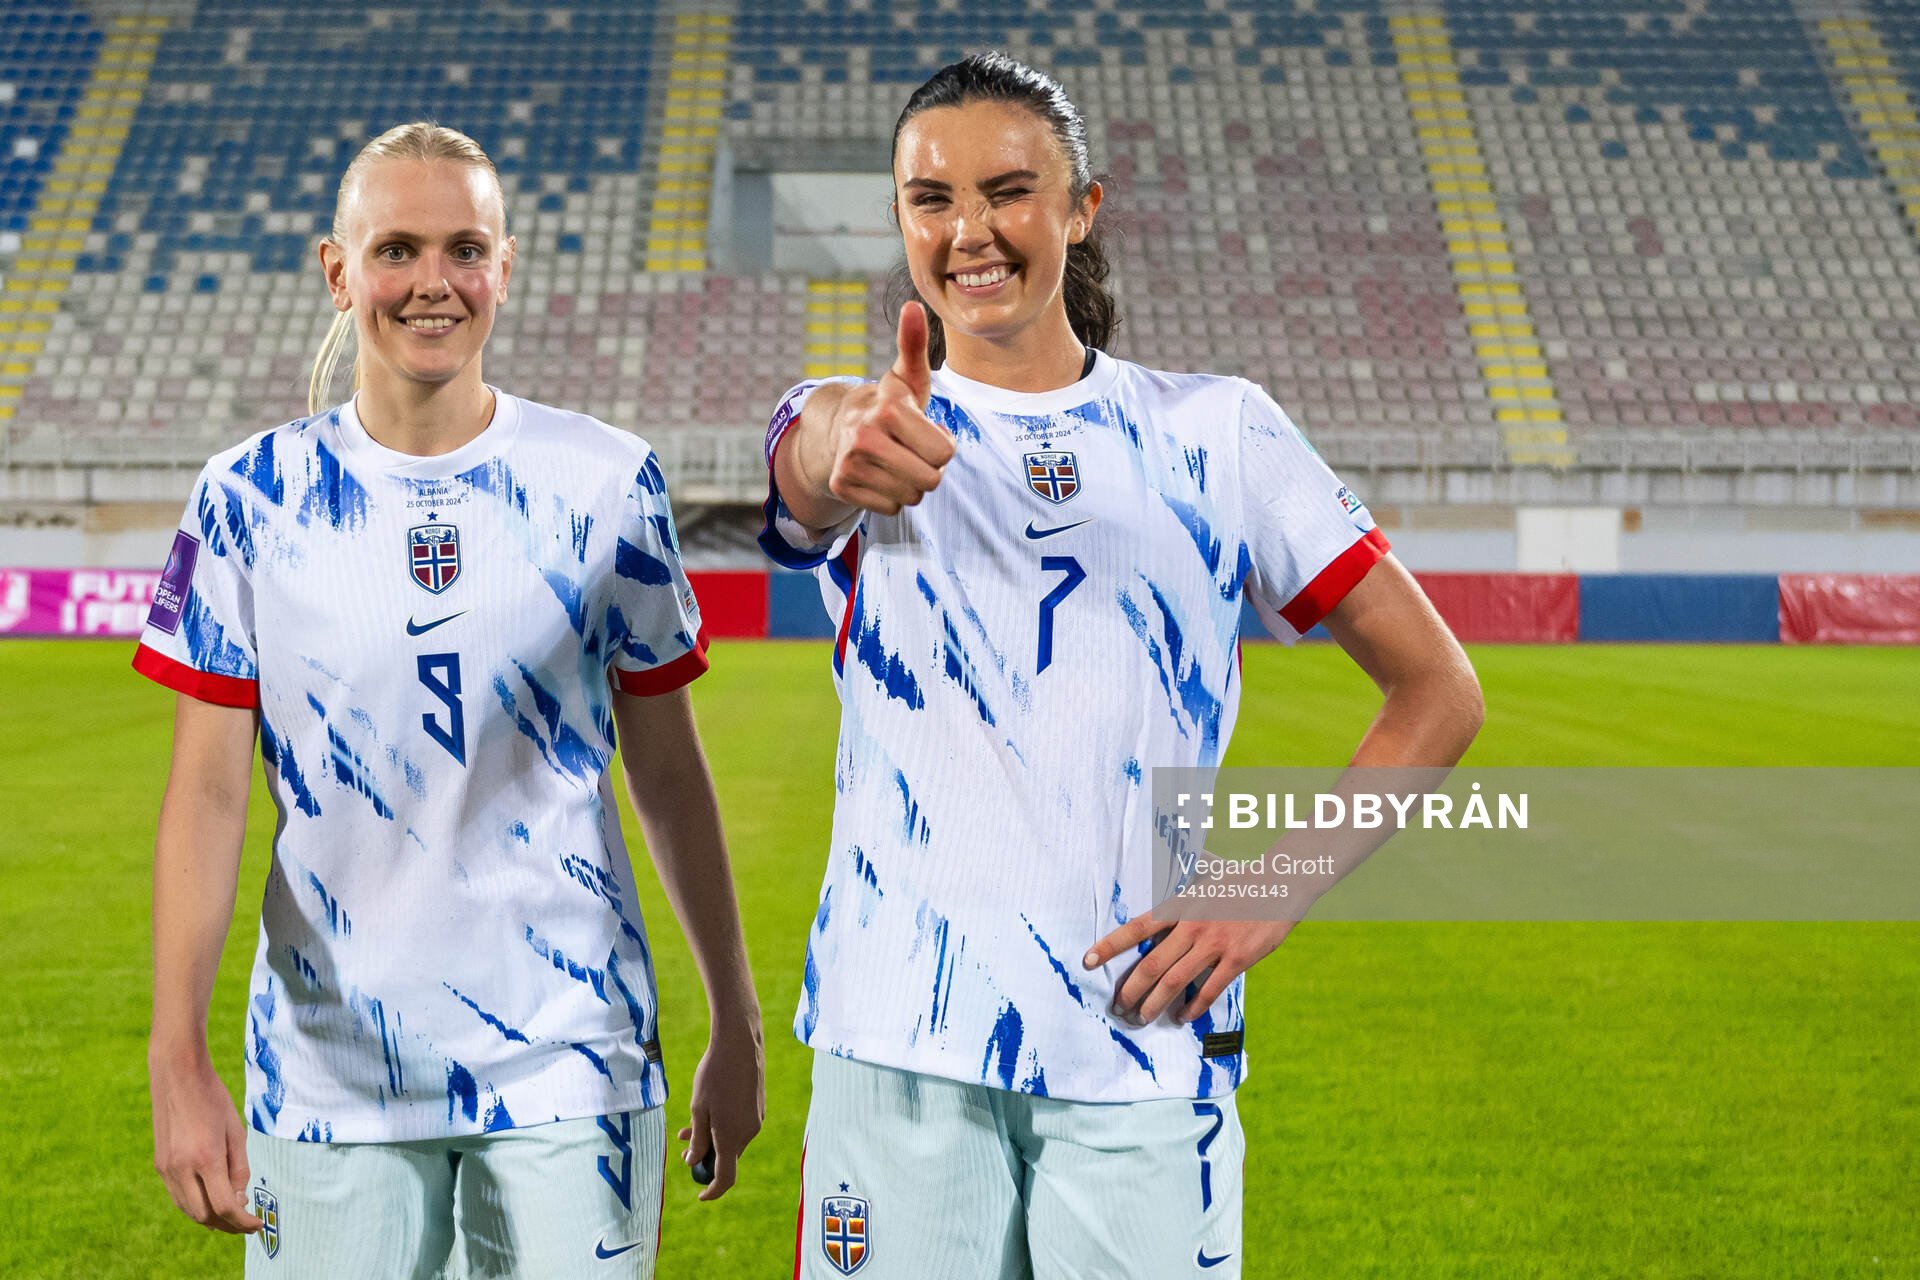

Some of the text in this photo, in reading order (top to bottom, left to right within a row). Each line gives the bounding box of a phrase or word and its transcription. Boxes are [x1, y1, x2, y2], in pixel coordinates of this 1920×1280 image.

[1015, 429, 1071, 442] 25 OCTOBER 2024
[1026, 422, 1056, 431] ALBANIA
[416, 499, 444, 507] OCTOBER
[446, 497, 461, 506] 2024
[419, 487, 448, 496] ALBANIA
[1036, 556, 1087, 676] 7
[417, 652, 466, 768] 9
[595, 1111, 633, 1214] 9
[1192, 1103, 1223, 1213] 7
